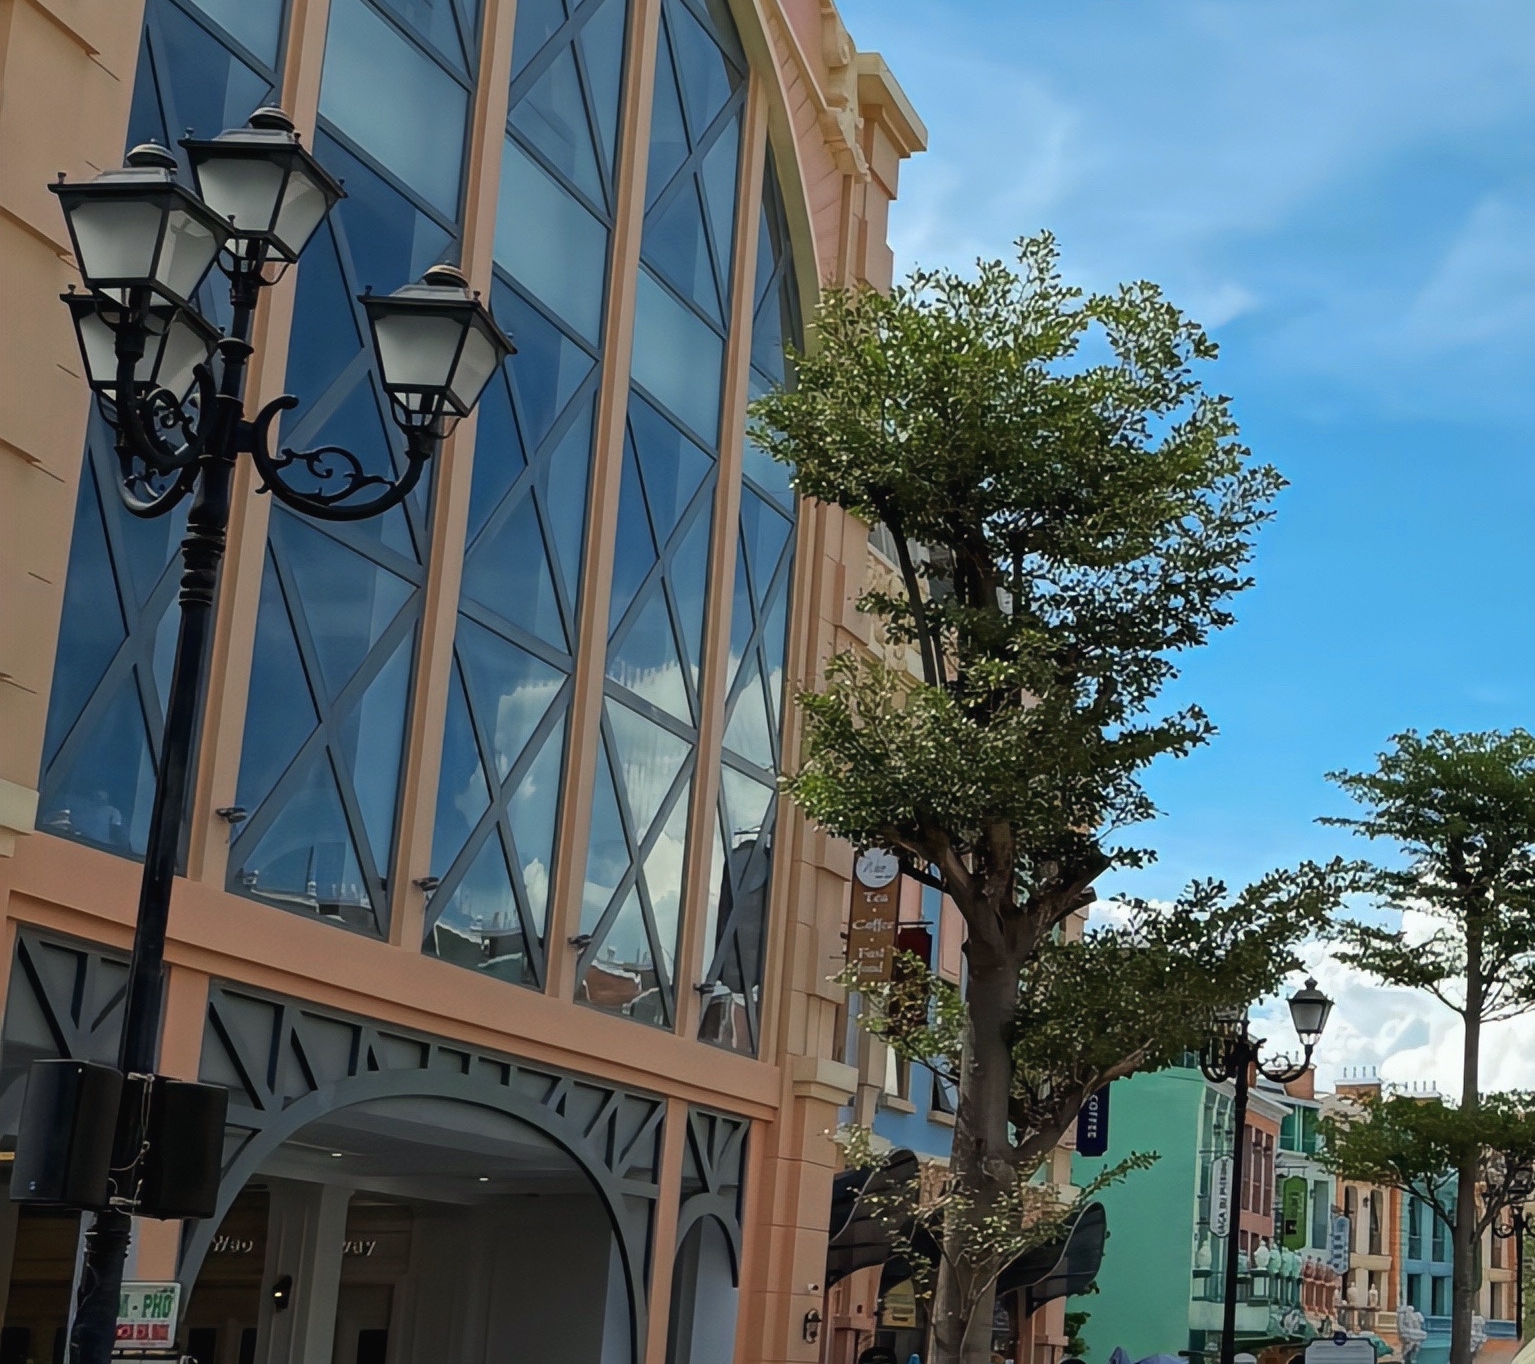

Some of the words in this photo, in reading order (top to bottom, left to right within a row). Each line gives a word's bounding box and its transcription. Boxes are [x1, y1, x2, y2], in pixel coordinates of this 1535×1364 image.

[863, 891, 889, 903] Tea
[852, 918, 894, 933] Coffee
[1088, 1094, 1099, 1139] COFFEE
